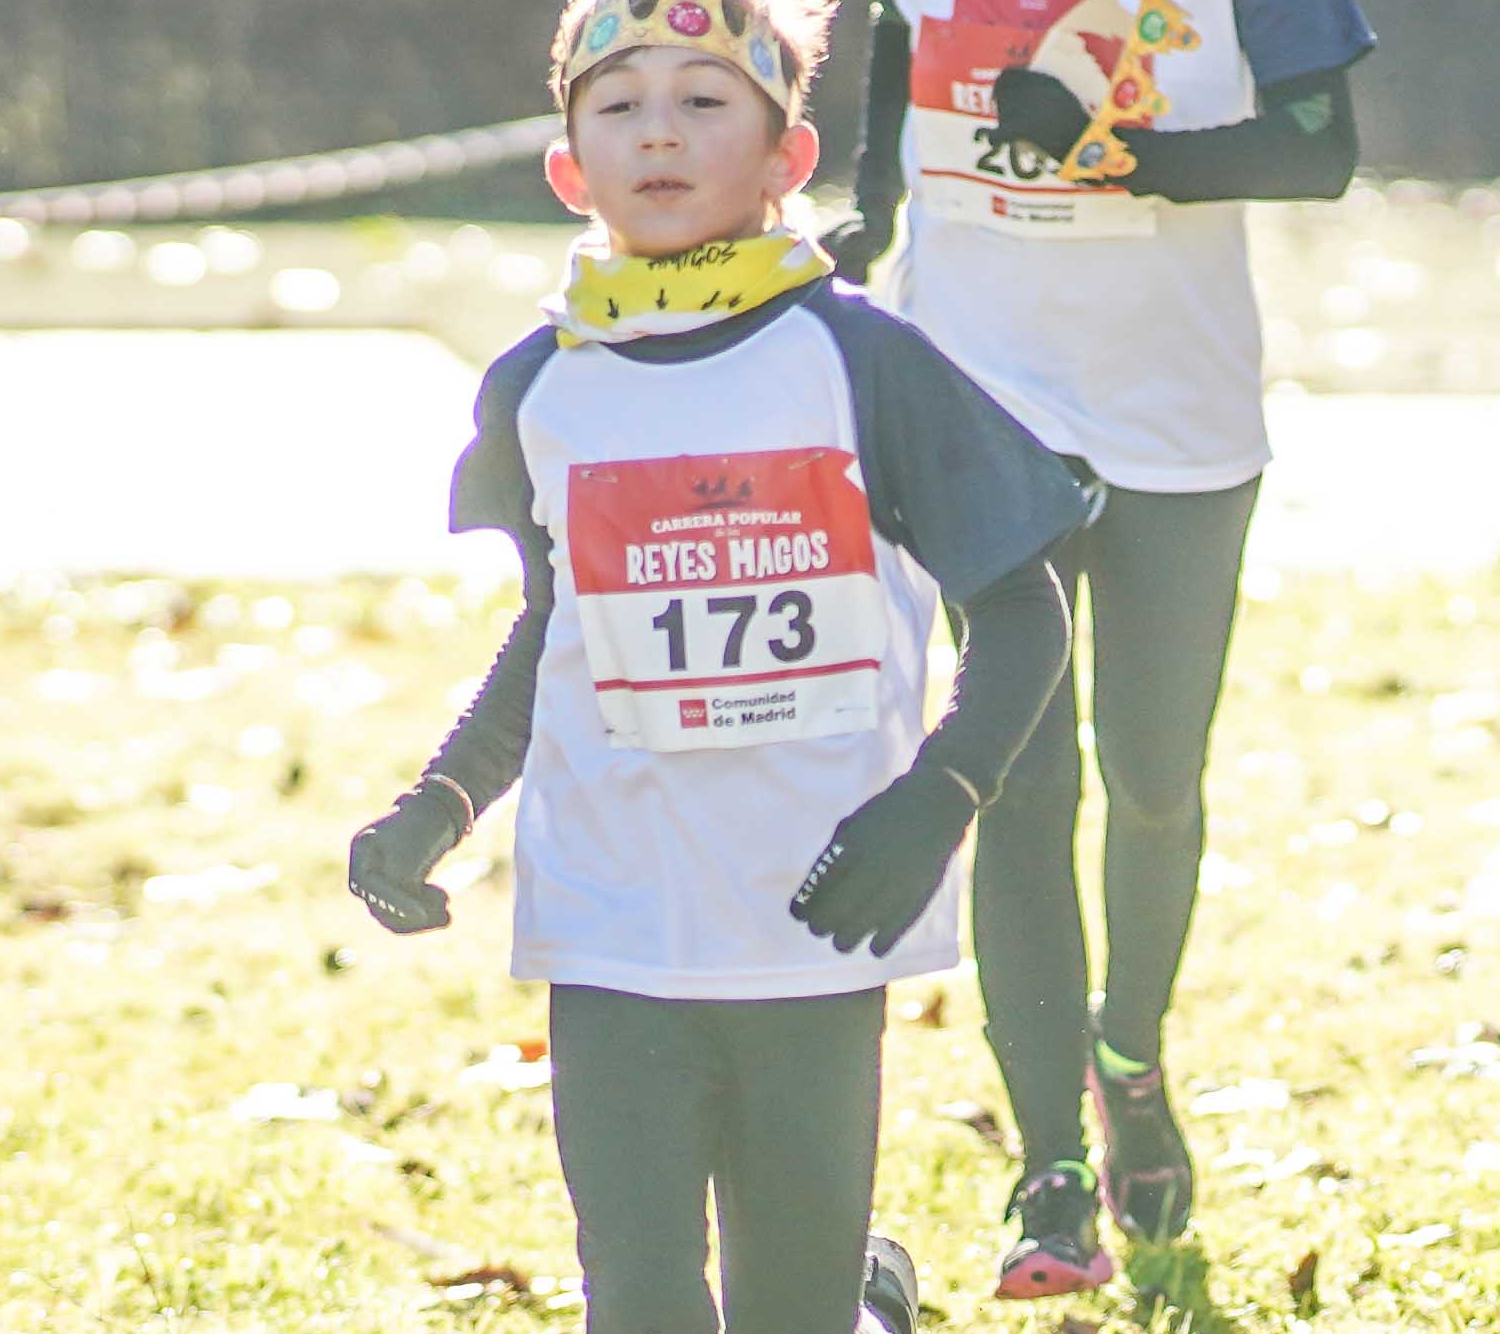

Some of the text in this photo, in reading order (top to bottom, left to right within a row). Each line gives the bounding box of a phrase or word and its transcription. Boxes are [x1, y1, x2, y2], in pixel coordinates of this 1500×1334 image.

[650, 513, 725, 534] CARRERA
[727, 511, 803, 526] POPULAR
[626, 529, 829, 585] REYES MAGOS
[652, 590, 816, 672] 173
[712, 691, 796, 710] Comunidad
[713, 707, 796, 727] de Madrid
